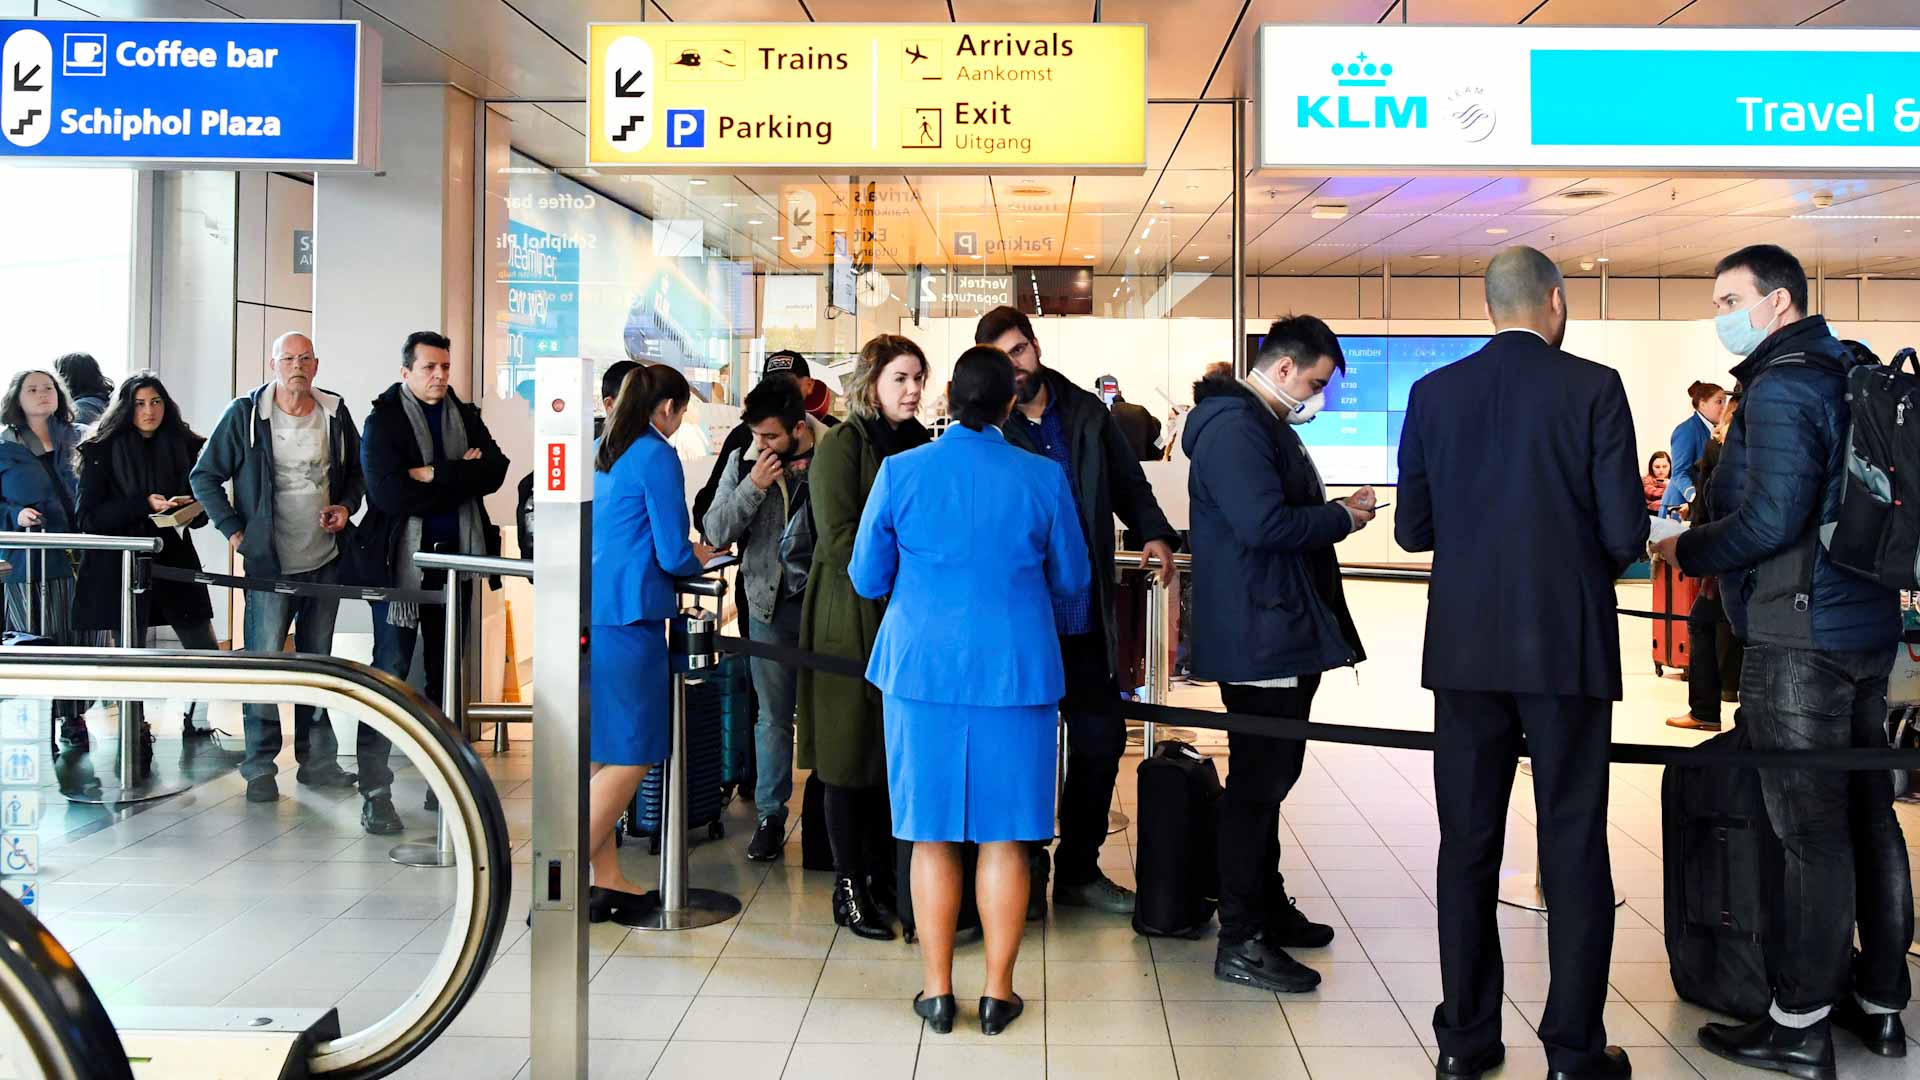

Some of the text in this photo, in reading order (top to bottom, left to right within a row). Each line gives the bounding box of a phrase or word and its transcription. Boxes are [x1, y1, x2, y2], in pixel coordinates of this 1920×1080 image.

[116, 40, 278, 68] Coffee bar
[758, 46, 848, 70] Trains
[956, 33, 1073, 57] Arrivals
[957, 64, 1053, 81] Aankomst
[60, 108, 281, 140] Schiphol Plaza
[956, 101, 1011, 125] Exit
[1297, 95, 1427, 128] KLM
[1736, 93, 1920, 133] Travel &
[673, 113, 698, 146] P
[719, 114, 832, 145] Parking
[956, 135, 1031, 154] Uitgang
[1348, 348, 1382, 357] number
[551, 445, 562, 489] STOP
